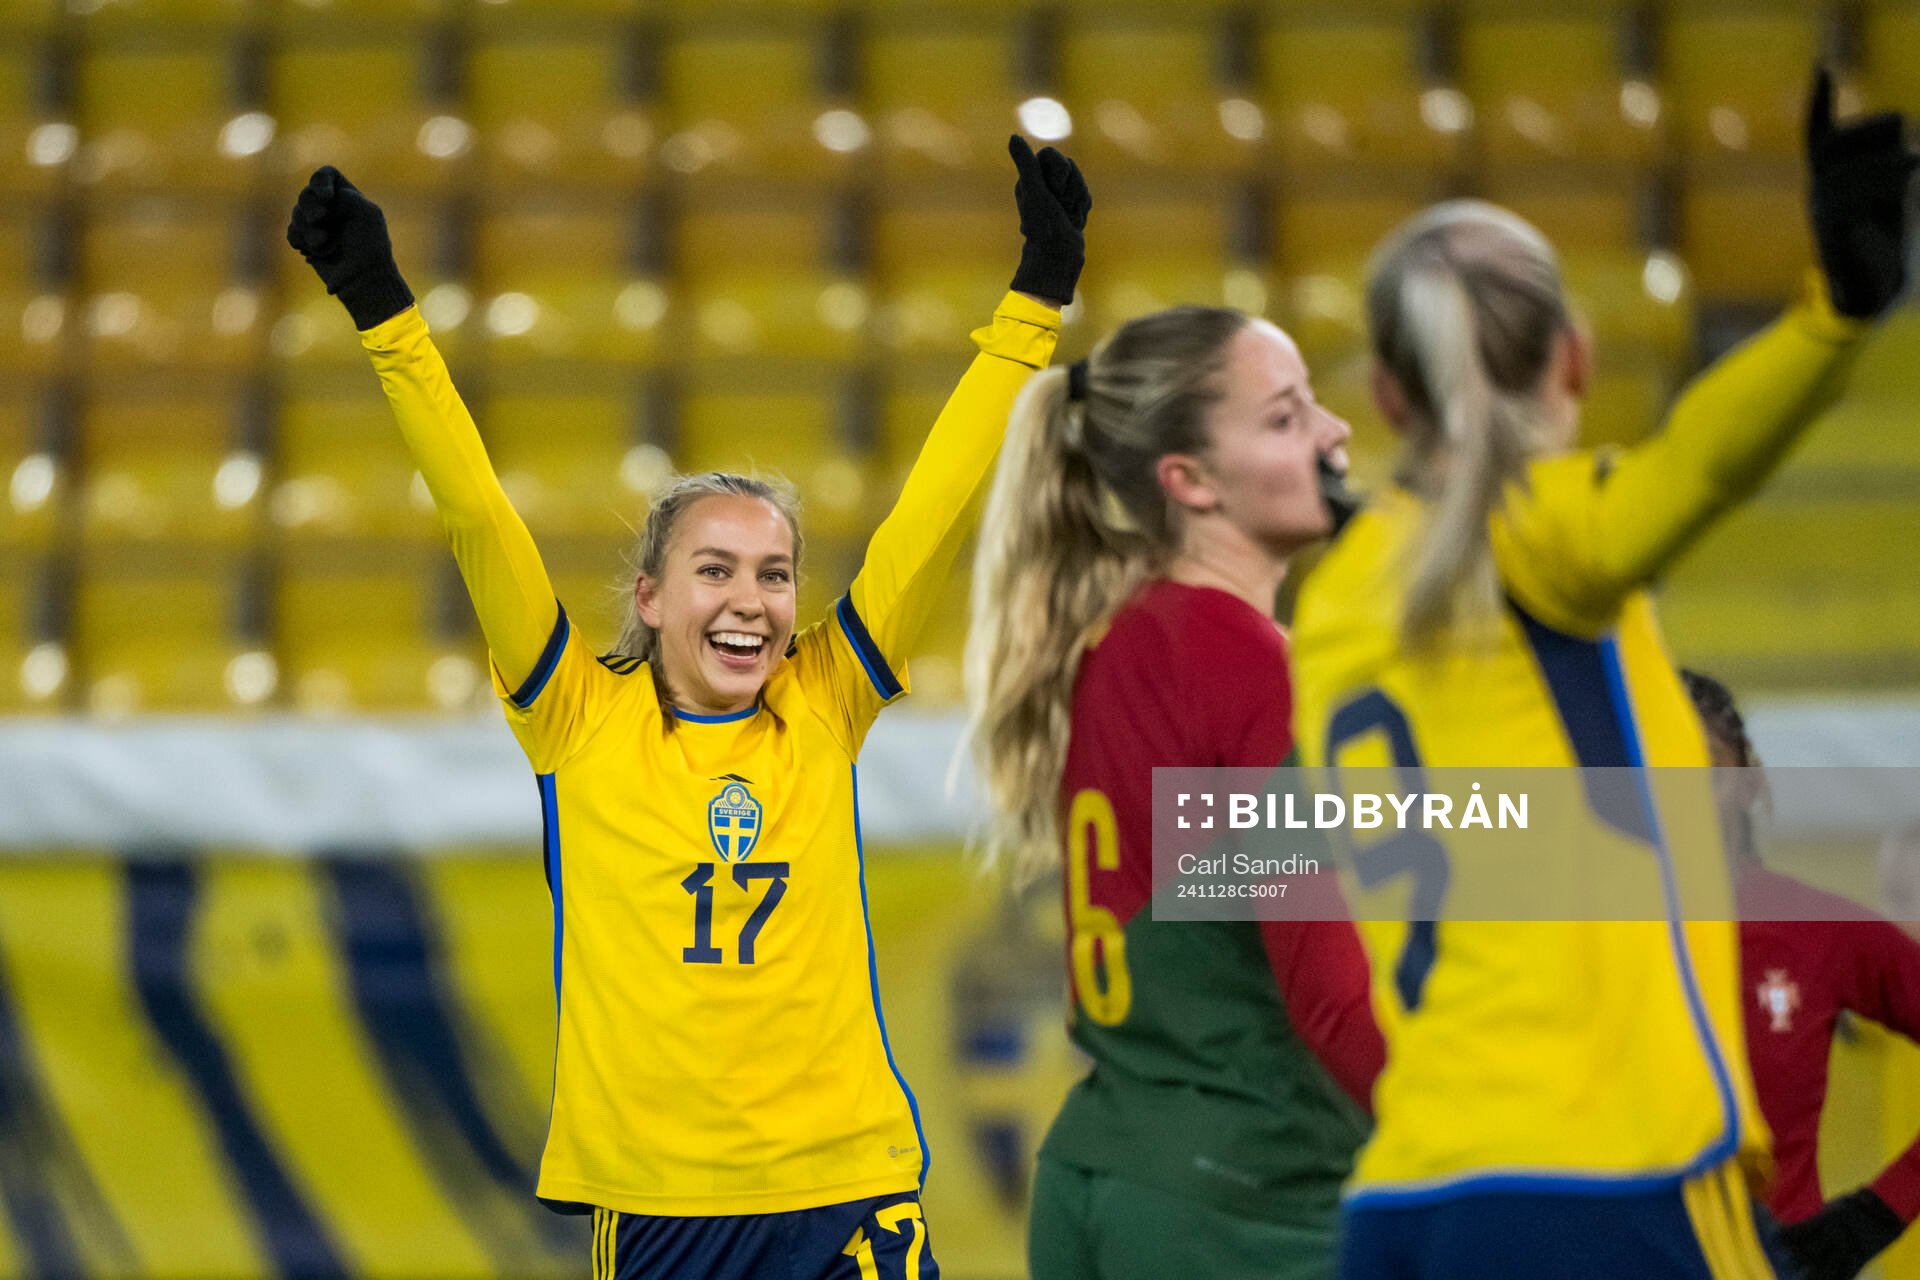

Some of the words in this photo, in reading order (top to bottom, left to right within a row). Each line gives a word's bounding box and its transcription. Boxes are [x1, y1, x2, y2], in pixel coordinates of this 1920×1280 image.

[719, 808, 751, 816] SVERIGE
[1324, 688, 1453, 1014] 9
[680, 862, 790, 965] 17
[1068, 788, 1132, 1027] 6
[841, 1202, 926, 1280] 17
